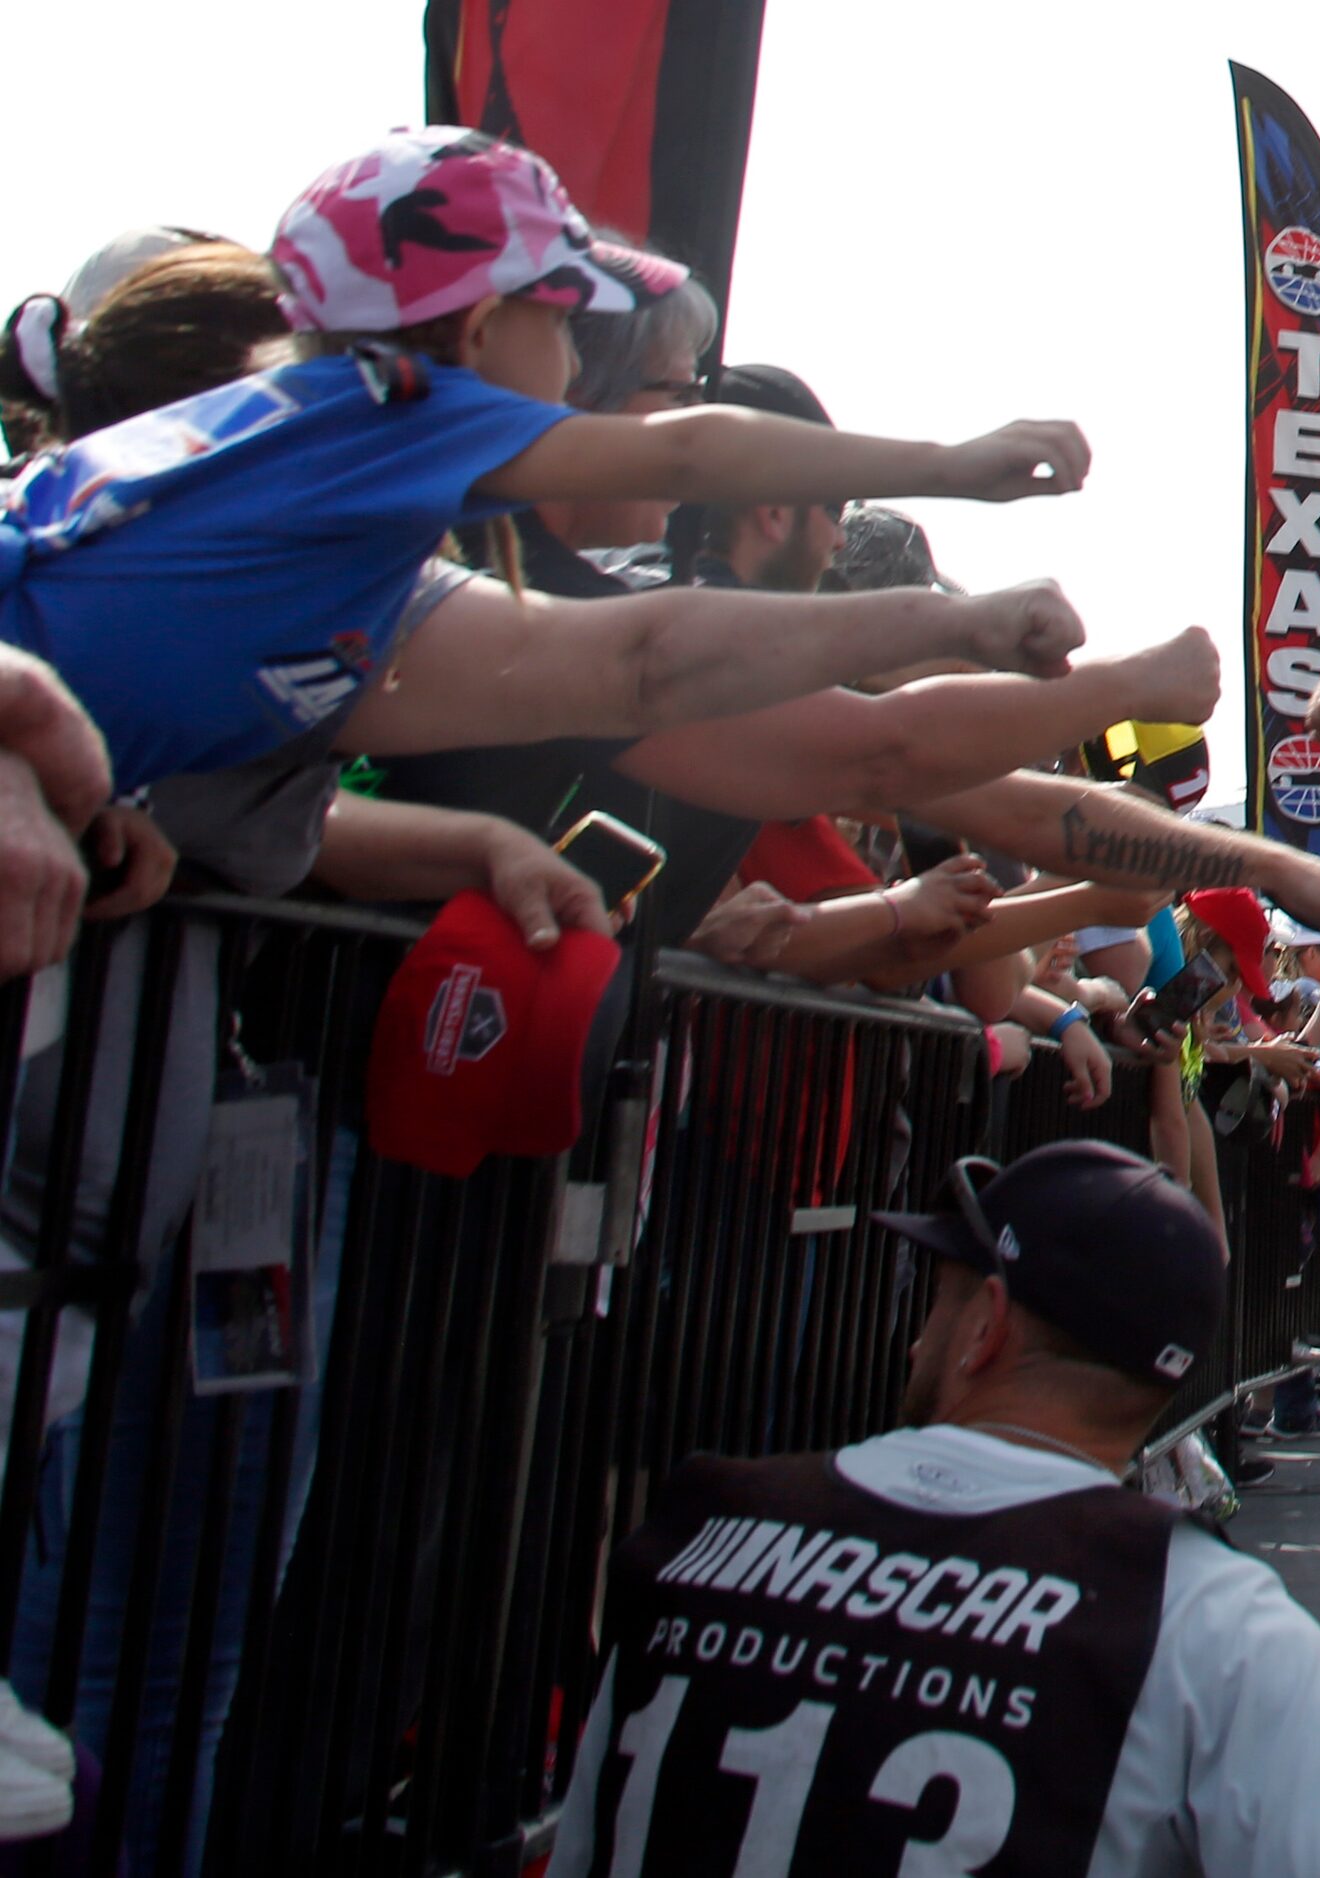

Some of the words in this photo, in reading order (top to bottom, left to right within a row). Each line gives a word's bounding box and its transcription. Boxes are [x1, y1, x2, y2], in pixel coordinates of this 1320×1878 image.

[738, 1523, 1080, 1653] NASCAR
[647, 1617, 1037, 1729] PRODUCTIONS
[608, 1674, 1016, 1878] 113
